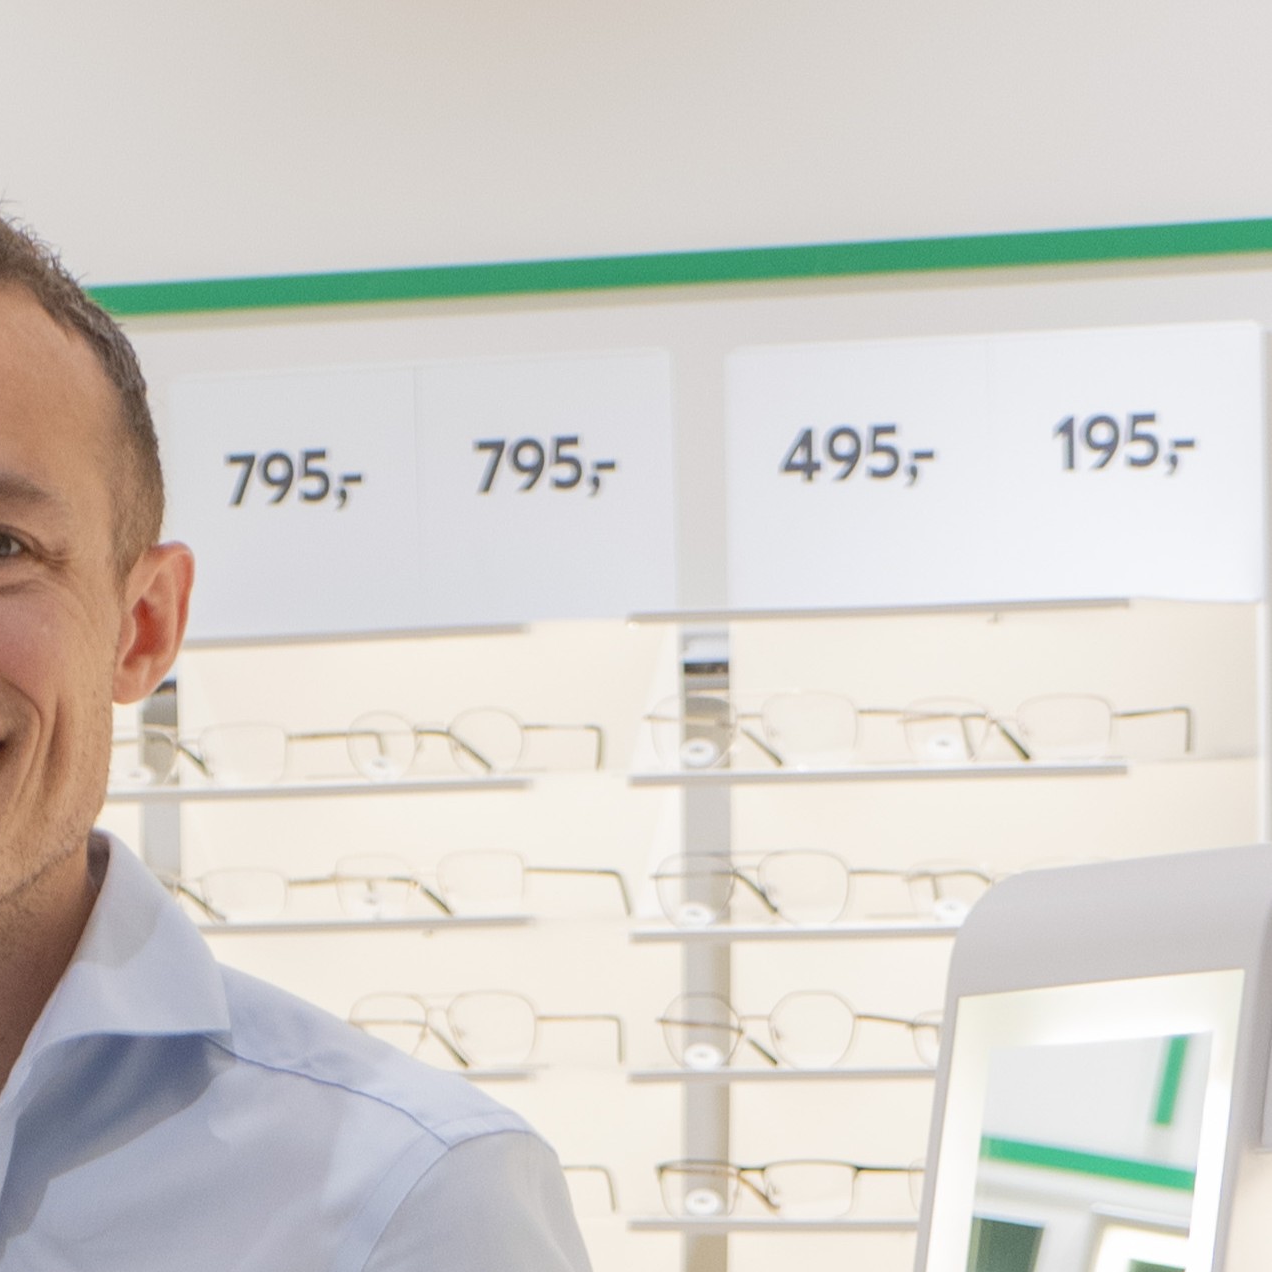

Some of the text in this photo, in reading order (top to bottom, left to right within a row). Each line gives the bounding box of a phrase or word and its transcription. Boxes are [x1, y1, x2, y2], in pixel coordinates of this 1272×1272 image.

[474, 435, 617, 496] 795,-
[780, 423, 936, 487] 495,-
[1053, 412, 1196, 475] 195,-
[225, 448, 363, 510] 795,-
